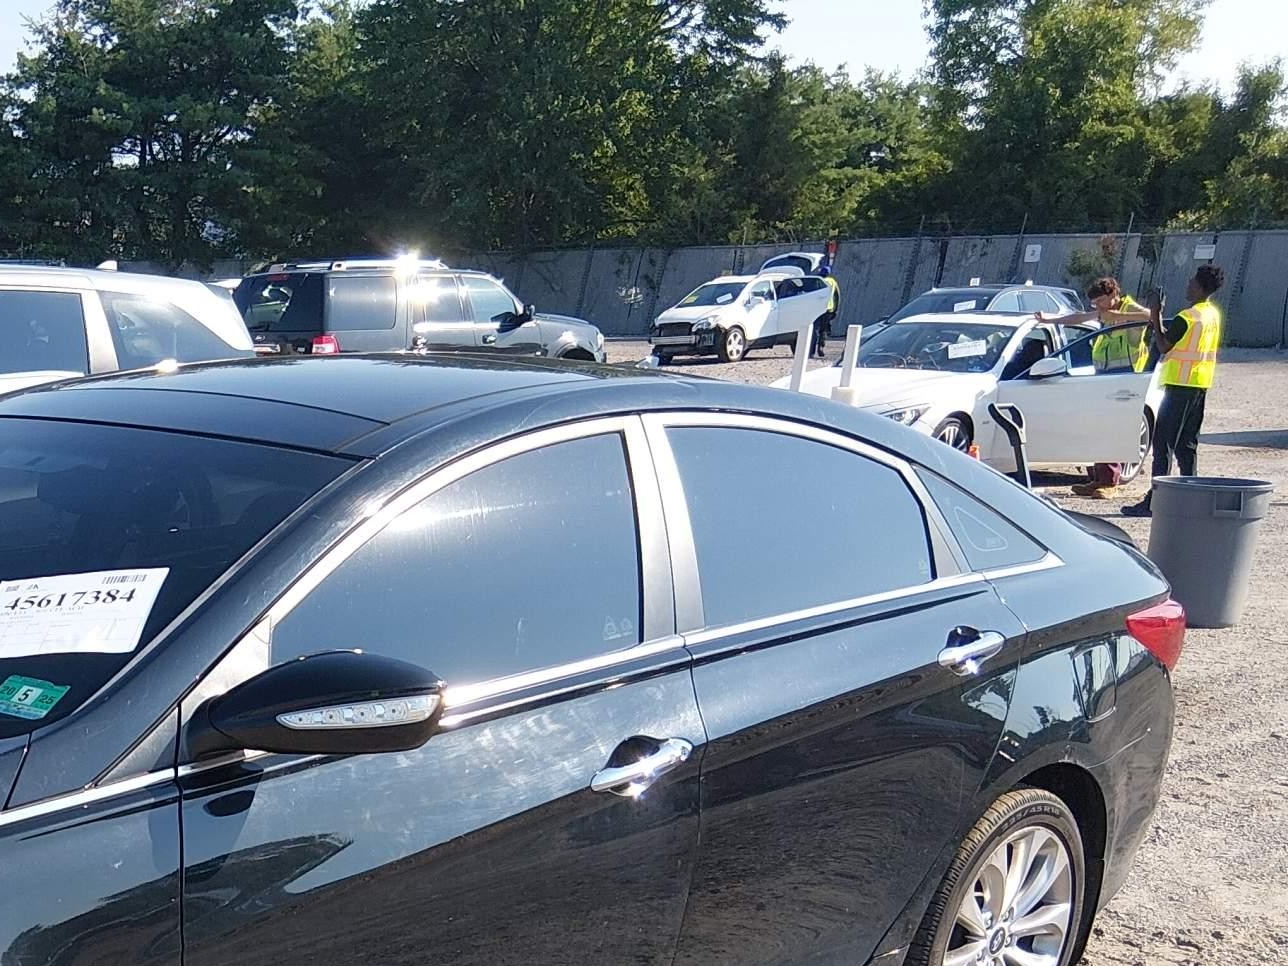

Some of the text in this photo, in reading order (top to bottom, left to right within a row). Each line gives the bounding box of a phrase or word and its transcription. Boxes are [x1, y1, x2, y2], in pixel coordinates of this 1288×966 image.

[4, 588, 137, 611] 45617384
[0, 685, 56, 705] 20 5 25
